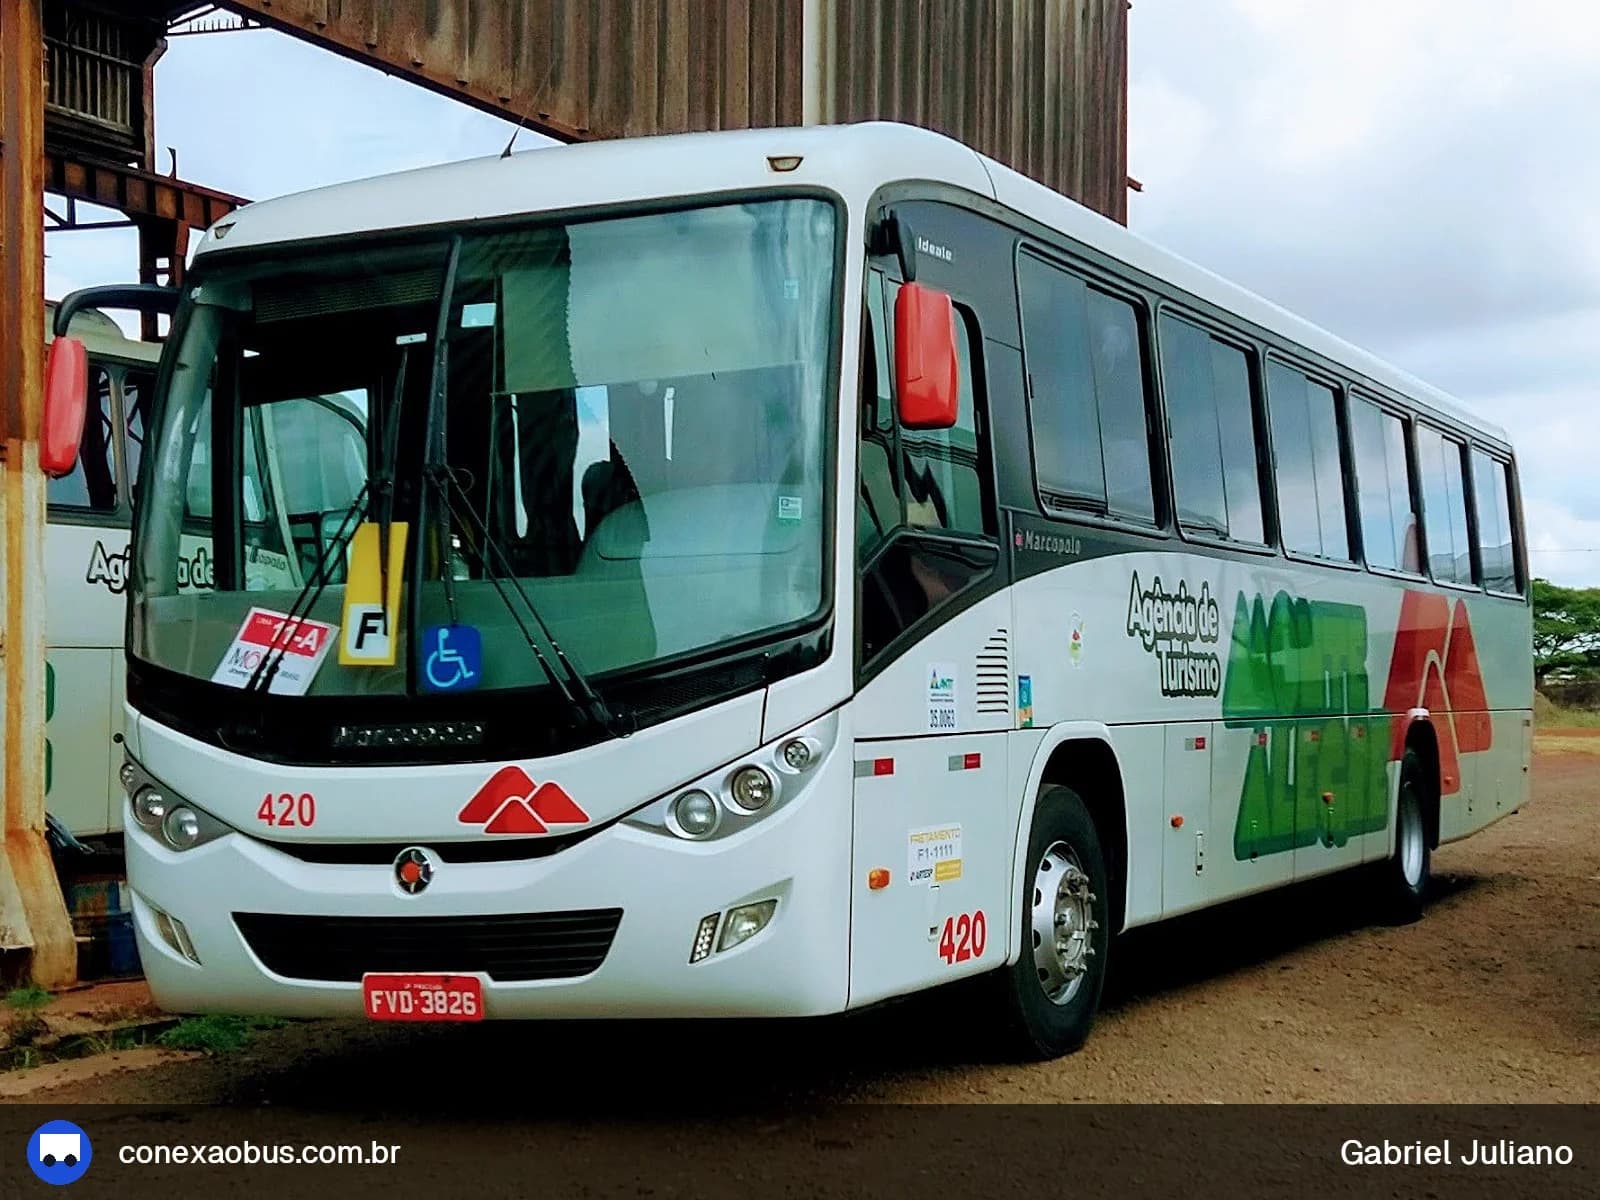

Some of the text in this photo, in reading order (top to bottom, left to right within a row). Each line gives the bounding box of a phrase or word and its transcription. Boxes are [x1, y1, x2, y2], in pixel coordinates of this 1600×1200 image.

[1025, 529, 1081, 556] Marcopolo
[355, 612, 384, 650] F
[1126, 569, 1219, 652] Agência de
[1155, 639, 1220, 698] Turismo
[257, 793, 315, 827] 420
[938, 909, 987, 966] 420
